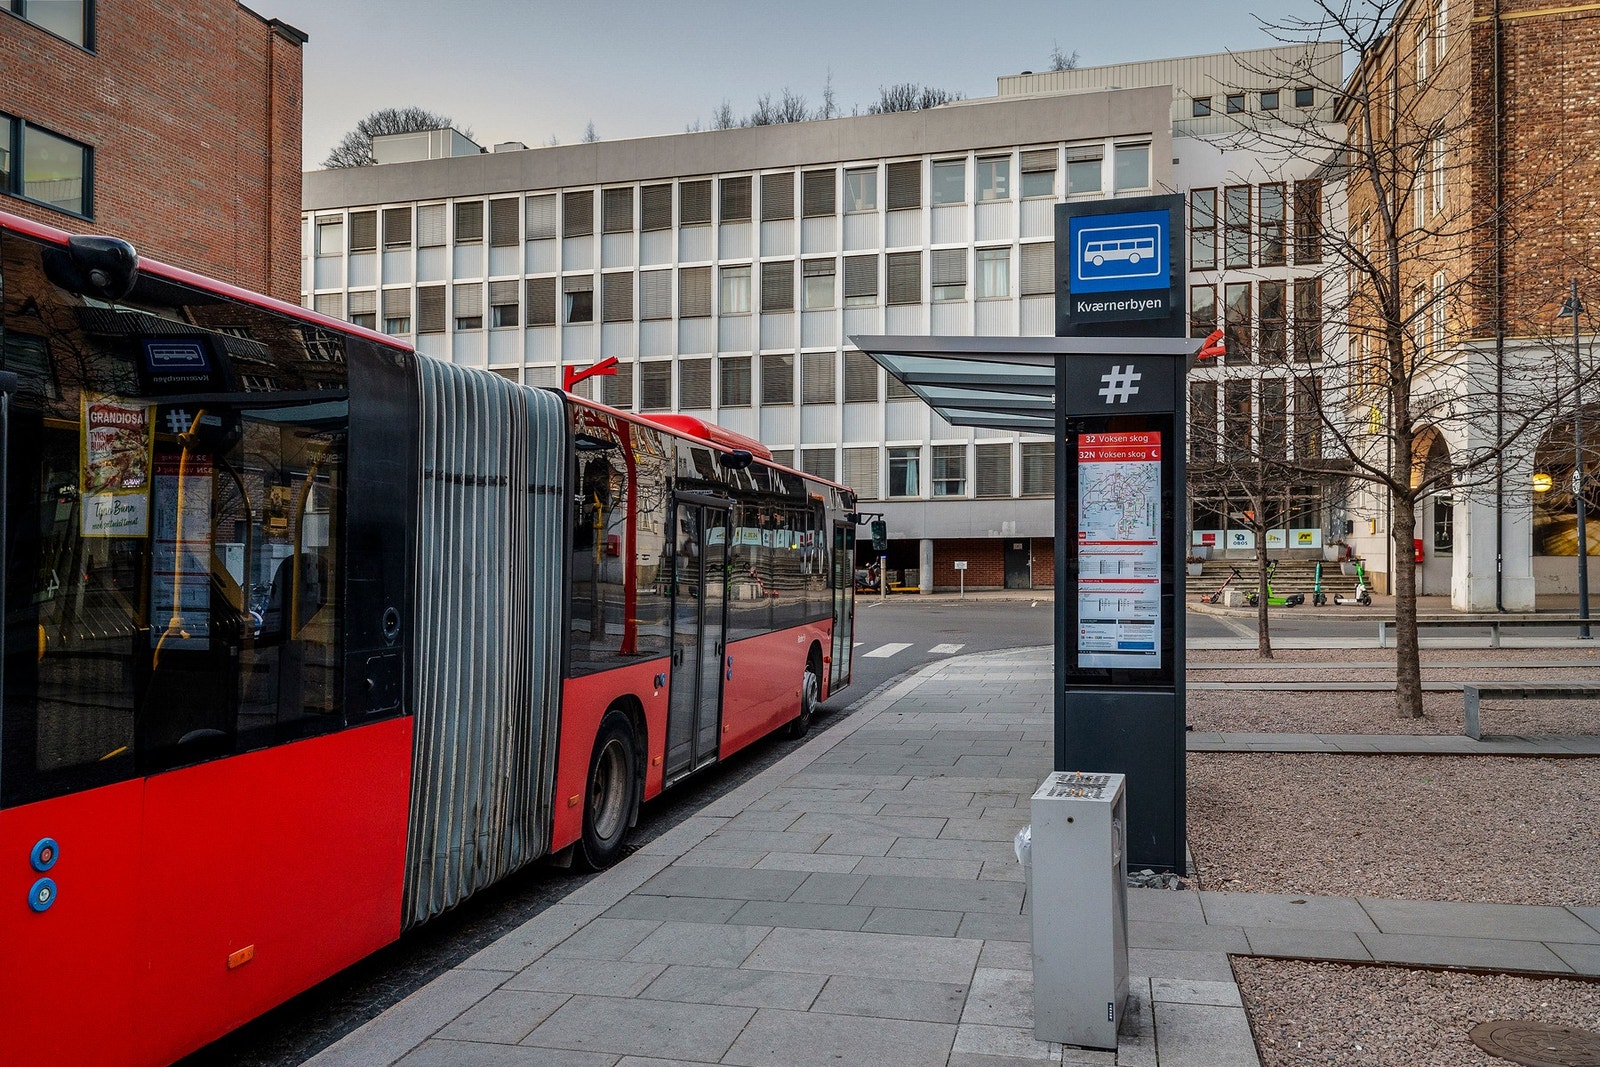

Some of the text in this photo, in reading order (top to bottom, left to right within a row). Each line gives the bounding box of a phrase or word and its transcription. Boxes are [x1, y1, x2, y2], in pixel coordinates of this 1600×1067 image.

[1077, 298, 1162, 313] Kværnerbyen
[90, 411, 144, 425] GRANDIOSA
[1085, 433, 1149, 444] 32 Voksen skog
[1079, 449, 1146, 460] 32N Voksen skog
